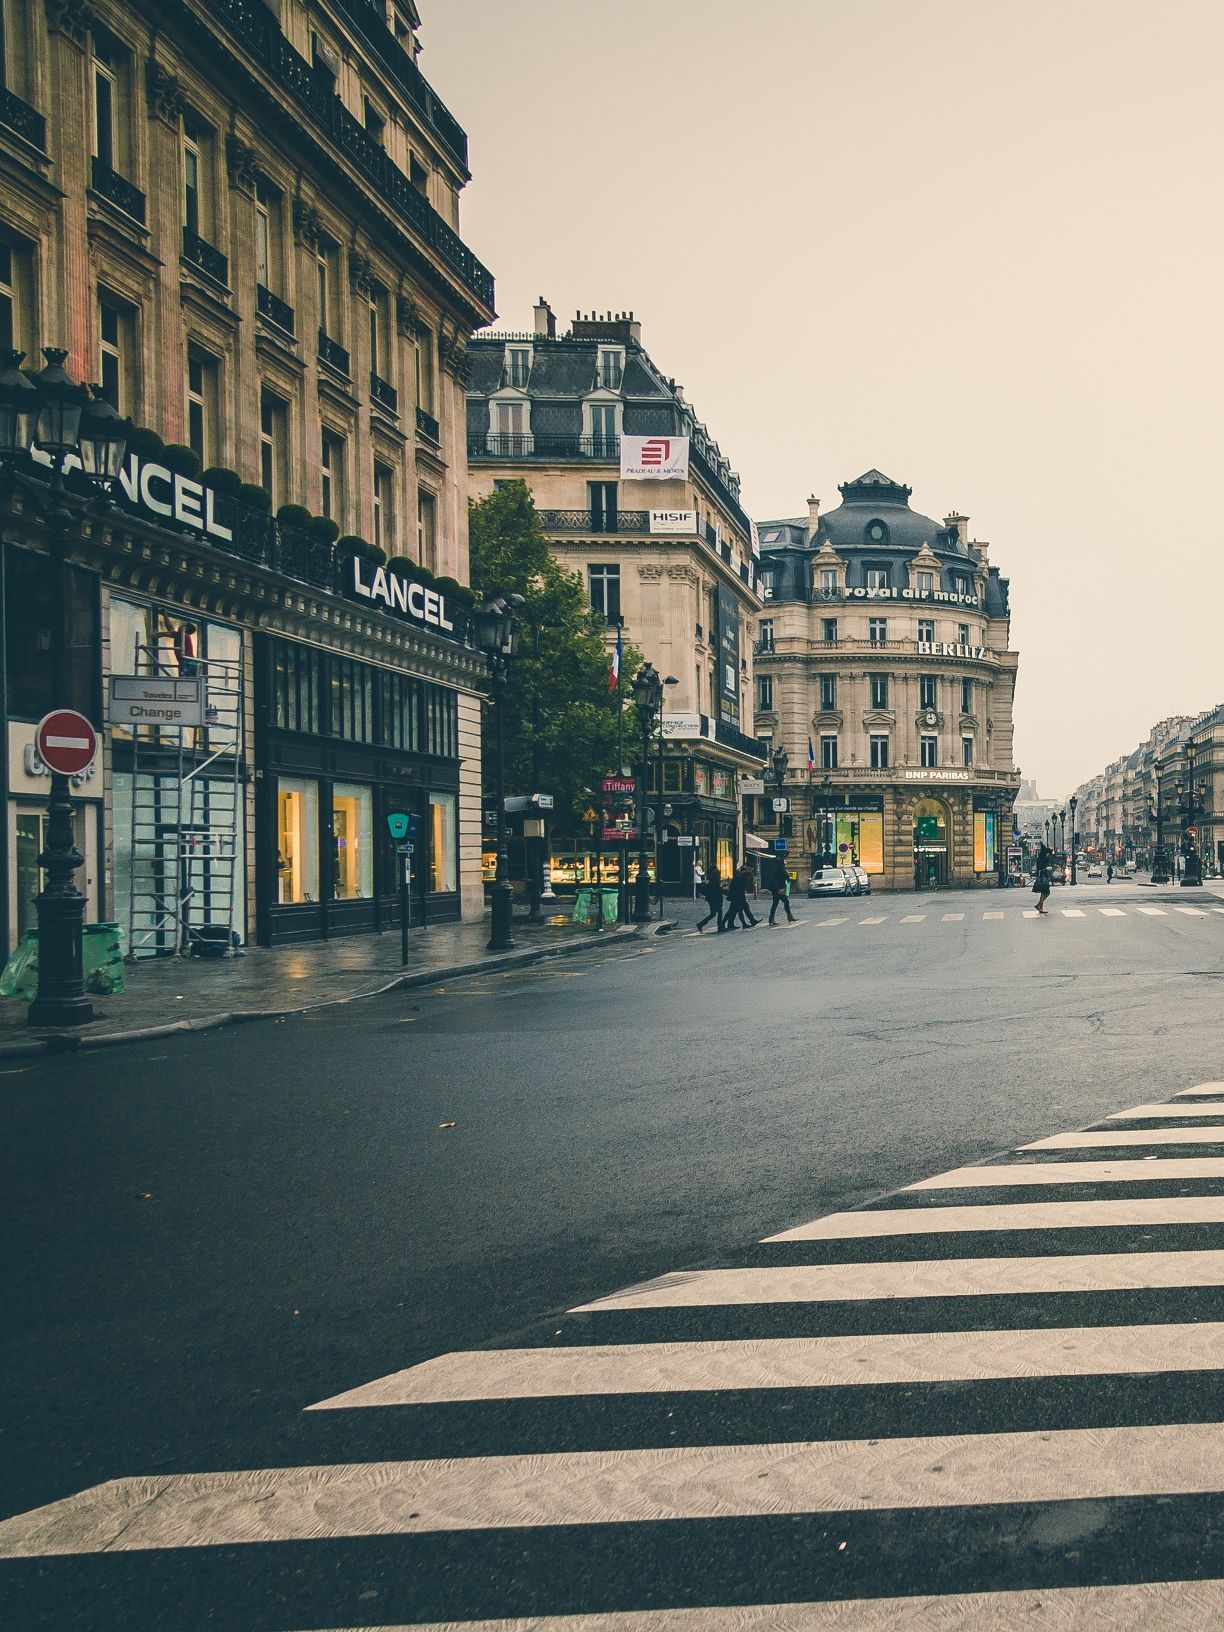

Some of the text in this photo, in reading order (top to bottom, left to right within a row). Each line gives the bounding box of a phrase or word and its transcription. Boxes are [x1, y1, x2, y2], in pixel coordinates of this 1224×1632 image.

[653, 512, 693, 521] HISIF
[354, 556, 453, 632] LANCEL
[845, 587, 978, 605] royal air maroc
[918, 641, 986, 660] BERLITZ
[129, 706, 182, 720] Change
[905, 771, 969, 780] BNP PARIBAS
[606, 781, 636, 793] Tiffany
